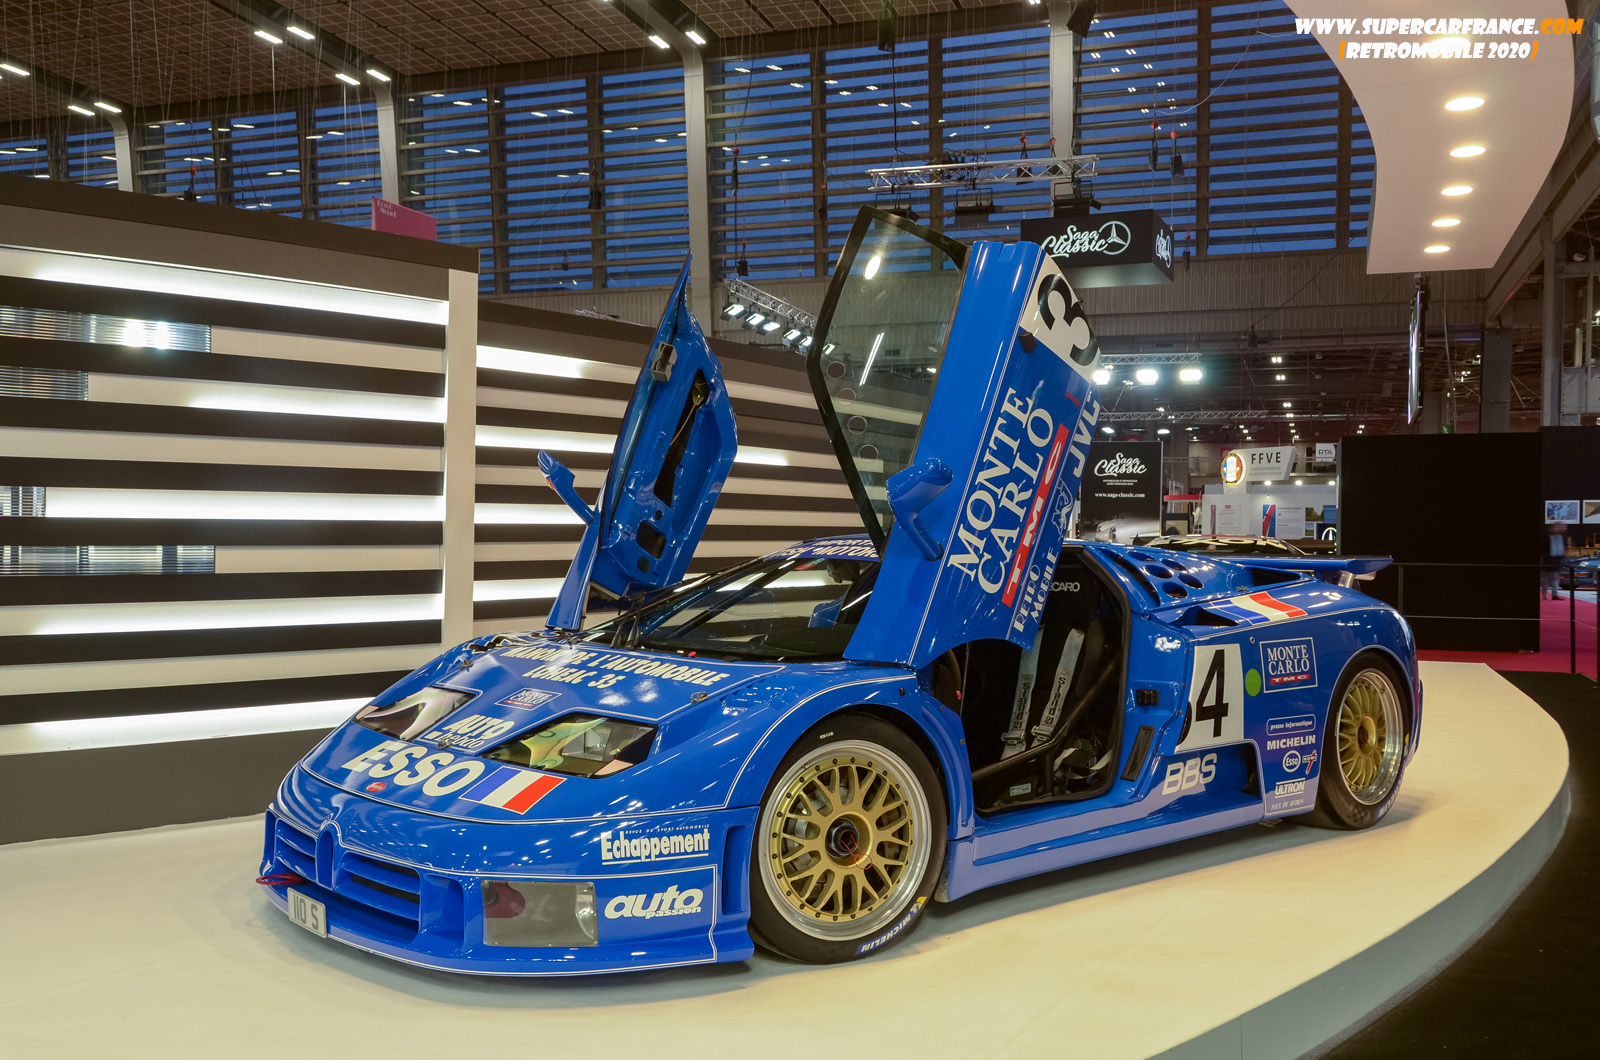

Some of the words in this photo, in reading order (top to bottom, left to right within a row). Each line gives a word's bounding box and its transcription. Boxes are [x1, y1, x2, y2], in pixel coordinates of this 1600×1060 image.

[1041, 235, 1109, 258] Classic
[1063, 225, 1099, 243] Saga
[1038, 273, 1099, 367] 3
[1069, 400, 1101, 478] JVC
[1094, 459, 1147, 477] Classic
[1113, 452, 1140, 466] Saga
[1251, 452, 1281, 464] FFVE
[947, 388, 1034, 582] MONTE
[978, 408, 1054, 594] CARLO
[1006, 440, 1061, 595] TMC
[1031, 546, 1059, 623] MOBILE
[1049, 581, 1080, 593] CARO
[1267, 645, 1309, 662] MONTE
[1268, 658, 1310, 675] CARLO
[566, 651, 598, 666] DE
[587, 654, 730, 687] L'AUTOMOBILE
[587, 674, 626, 689] 35
[1179, 649, 1229, 744] 4
[442, 714, 515, 740] AUTO
[441, 733, 485, 749] hebdo
[1267, 735, 1316, 750] MICHELIN
[341, 739, 485, 797] ESSO
[1162, 753, 1218, 796] BBS
[1275, 781, 1305, 795] ULTRON
[600, 828, 710, 862] Echappement
[604, 884, 704, 919] auto
[645, 906, 702, 919] passion
[311, 903, 319, 931] S
[861, 914, 911, 953] MICHELIN
